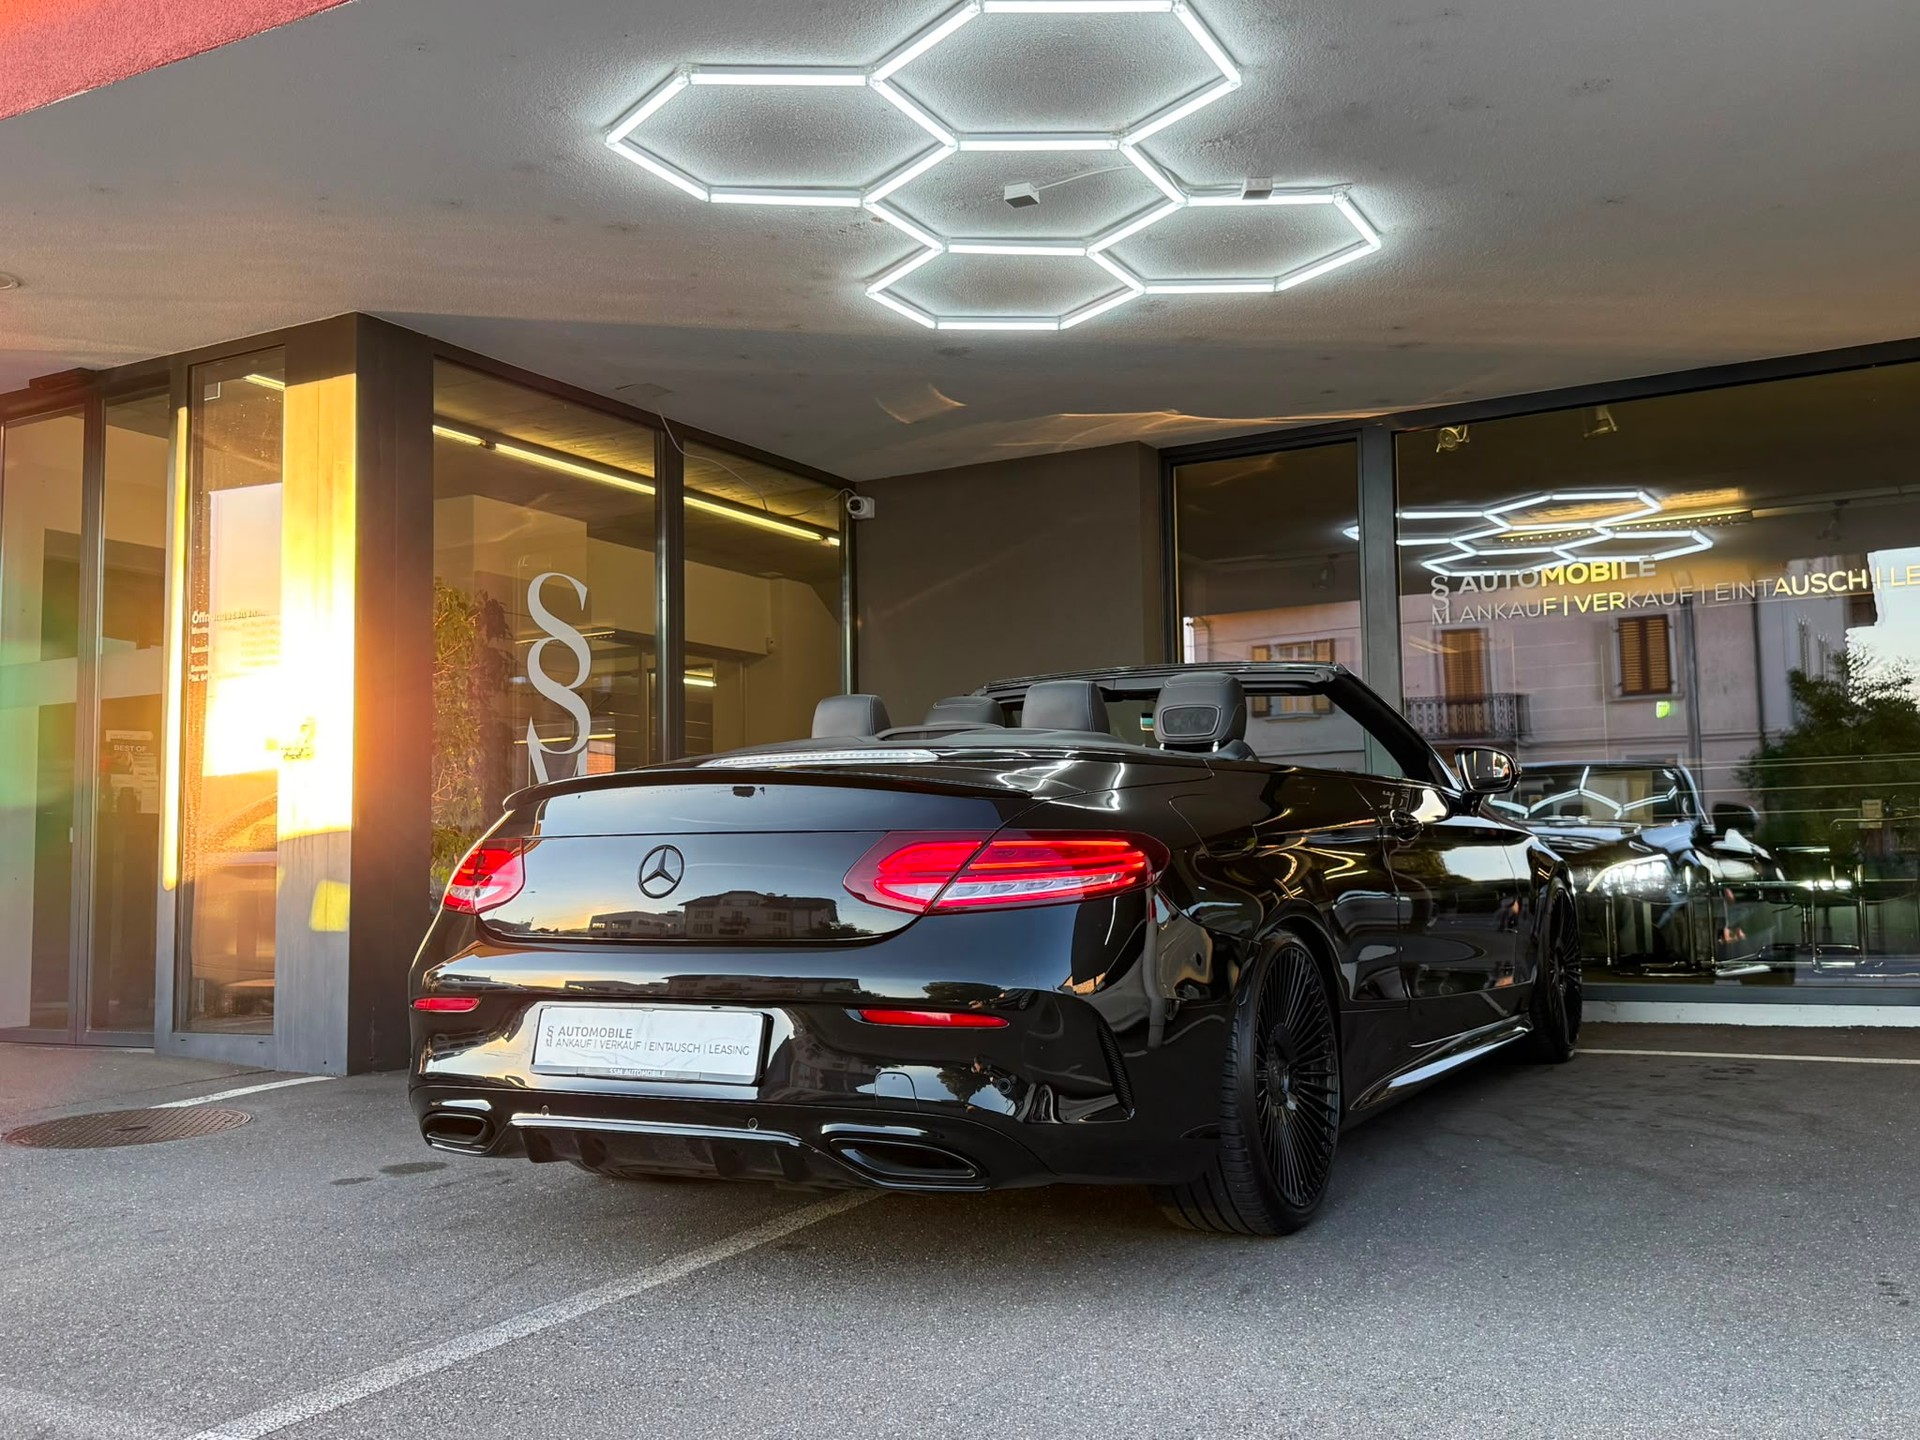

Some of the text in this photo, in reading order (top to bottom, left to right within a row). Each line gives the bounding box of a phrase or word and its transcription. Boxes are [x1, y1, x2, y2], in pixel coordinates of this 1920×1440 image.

[1458, 557, 1657, 594] AUTOMOBILE
[1460, 598, 1557, 623] ANKAUF
[1574, 585, 1693, 613] VERKAUF
[1715, 569, 1867, 602] EINTAUSCH
[558, 1026, 633, 1039] AUTOMOBILE
[555, 1038, 592, 1049] ANKAUF
[600, 1039, 642, 1051] VERKAUF
[649, 1041, 700, 1054] EINTAUSCH
[708, 1044, 750, 1056] LEASING
[624, 1069, 666, 1078] AUTOMOBILE
